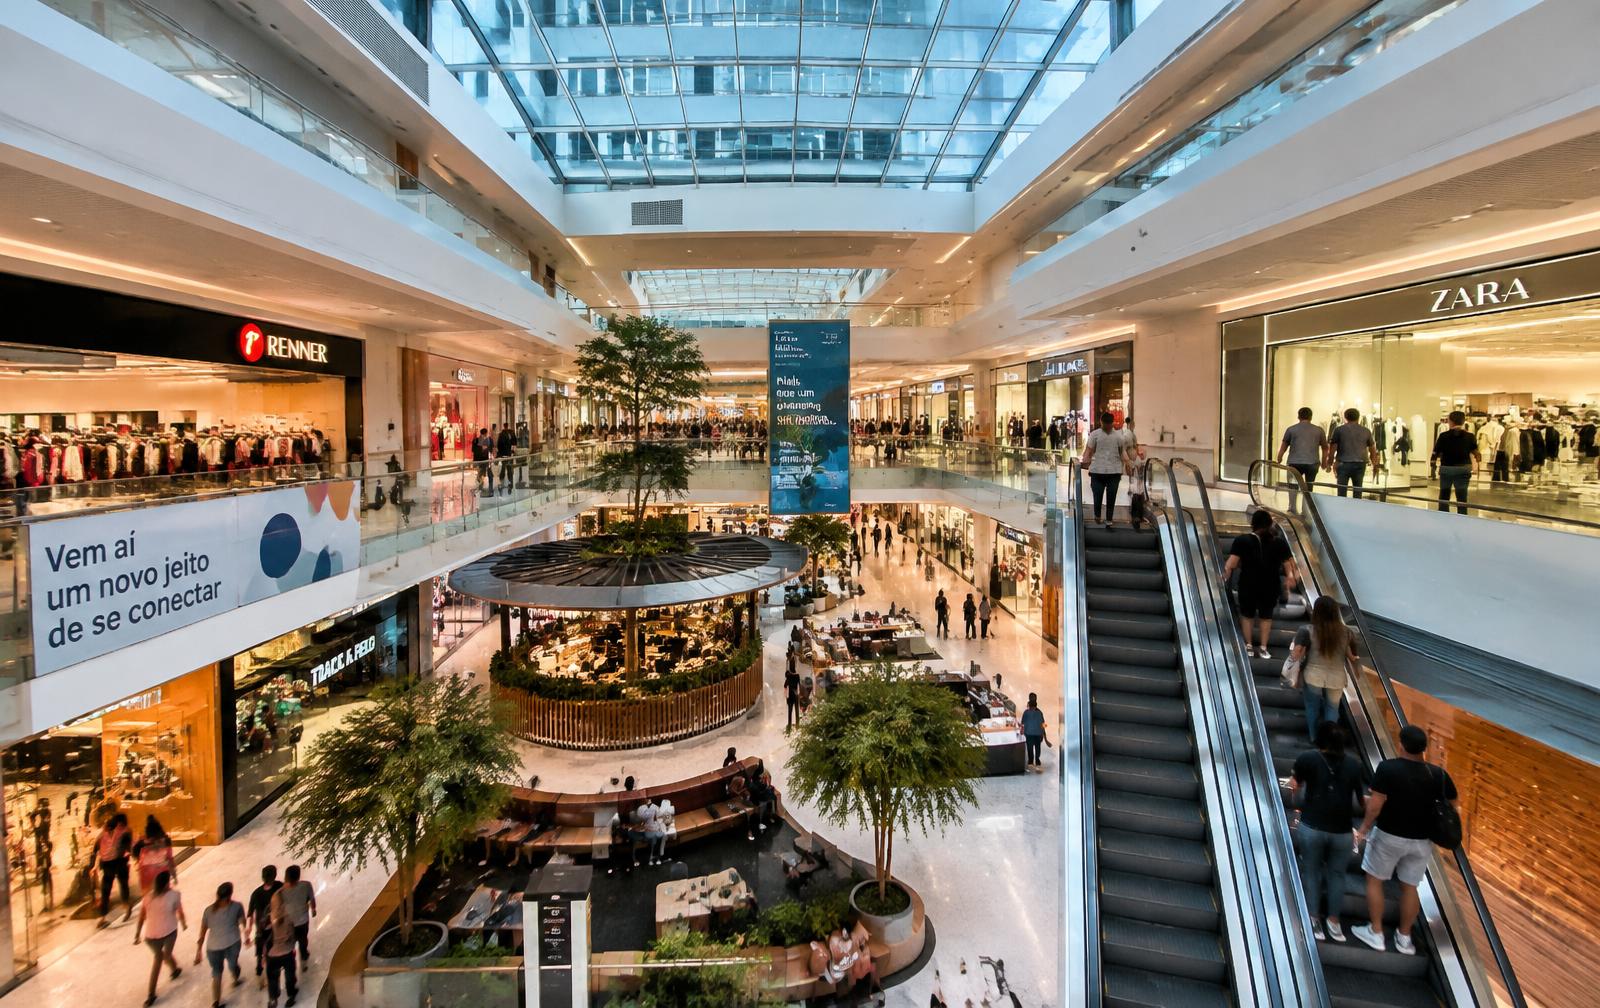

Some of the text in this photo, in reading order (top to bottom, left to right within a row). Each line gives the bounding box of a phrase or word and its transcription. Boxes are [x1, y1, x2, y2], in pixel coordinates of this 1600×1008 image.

[1430, 277, 1530, 313] ZARA
[267, 335, 328, 363] RENNER
[45, 530, 135, 573] Vem aí
[47, 552, 210, 611] um novo jeito
[48, 580, 222, 649] de se conectar
